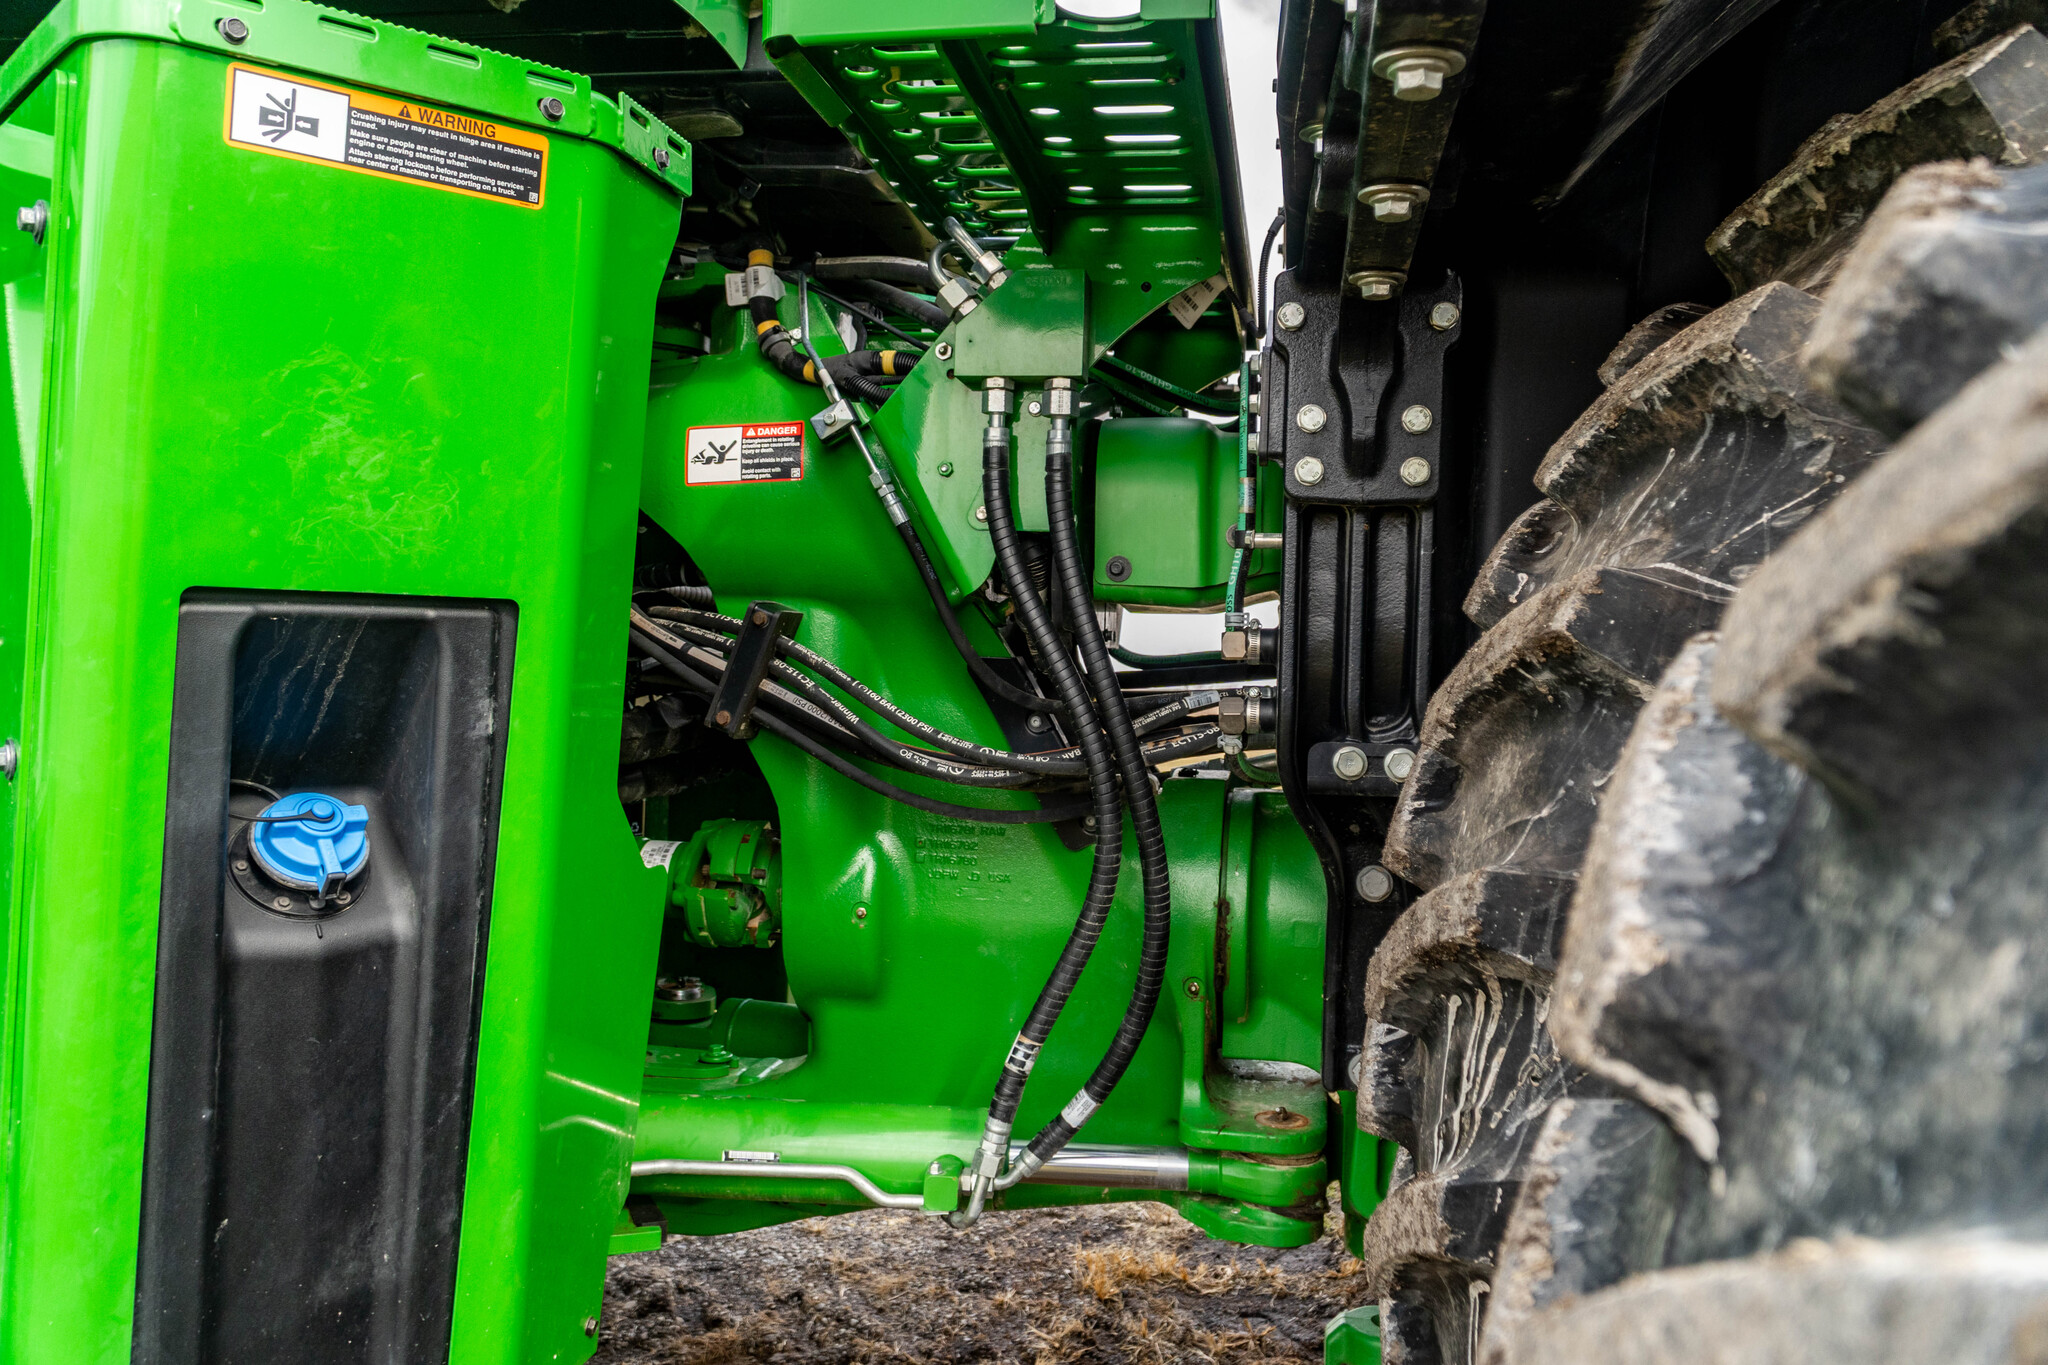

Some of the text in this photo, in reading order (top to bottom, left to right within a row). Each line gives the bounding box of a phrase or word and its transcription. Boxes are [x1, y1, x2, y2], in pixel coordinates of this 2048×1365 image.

[350, 117, 377, 130] turned.
[351, 109, 386, 125] Crushing
[387, 118, 409, 131] injury
[410, 124, 426, 134] may
[427, 127, 449, 138] result
[458, 134, 479, 146] hinge
[480, 140, 495, 149] area
[503, 145, 532, 158] machine
[418, 107, 496, 138] WARNING
[348, 146, 524, 190] Attach steering lockouts before performing services
[349, 136, 468, 168] engine or moving steering wheel.
[349, 128, 370, 139] Make
[371, 134, 388, 143] sure
[389, 137, 415, 150] people
[429, 146, 447, 156] clear
[448, 150, 456, 158] of
[457, 152, 487, 165] machine
[488, 159, 510, 170] before
[511, 164, 537, 177] starting
[348, 155, 364, 164] near
[366, 159, 389, 169] center
[390, 163, 398, 171] of
[399, 165, 429, 177] machine
[439, 173, 480, 190] transporting
[498, 186, 516, 196] truck.
[1125, 363, 1172, 391] GH100-10
[757, 426, 797, 435] DANGER
[1228, 549, 1242, 585] GH10
[773, 659, 860, 725] Winner EC115-08
[793, 696, 806, 709] PSI)
[807, 704, 828, 719] (2000
[866, 690, 934, 734] 160 BAR (2300 PSI)
[1171, 726, 1220, 748] EC115-08
